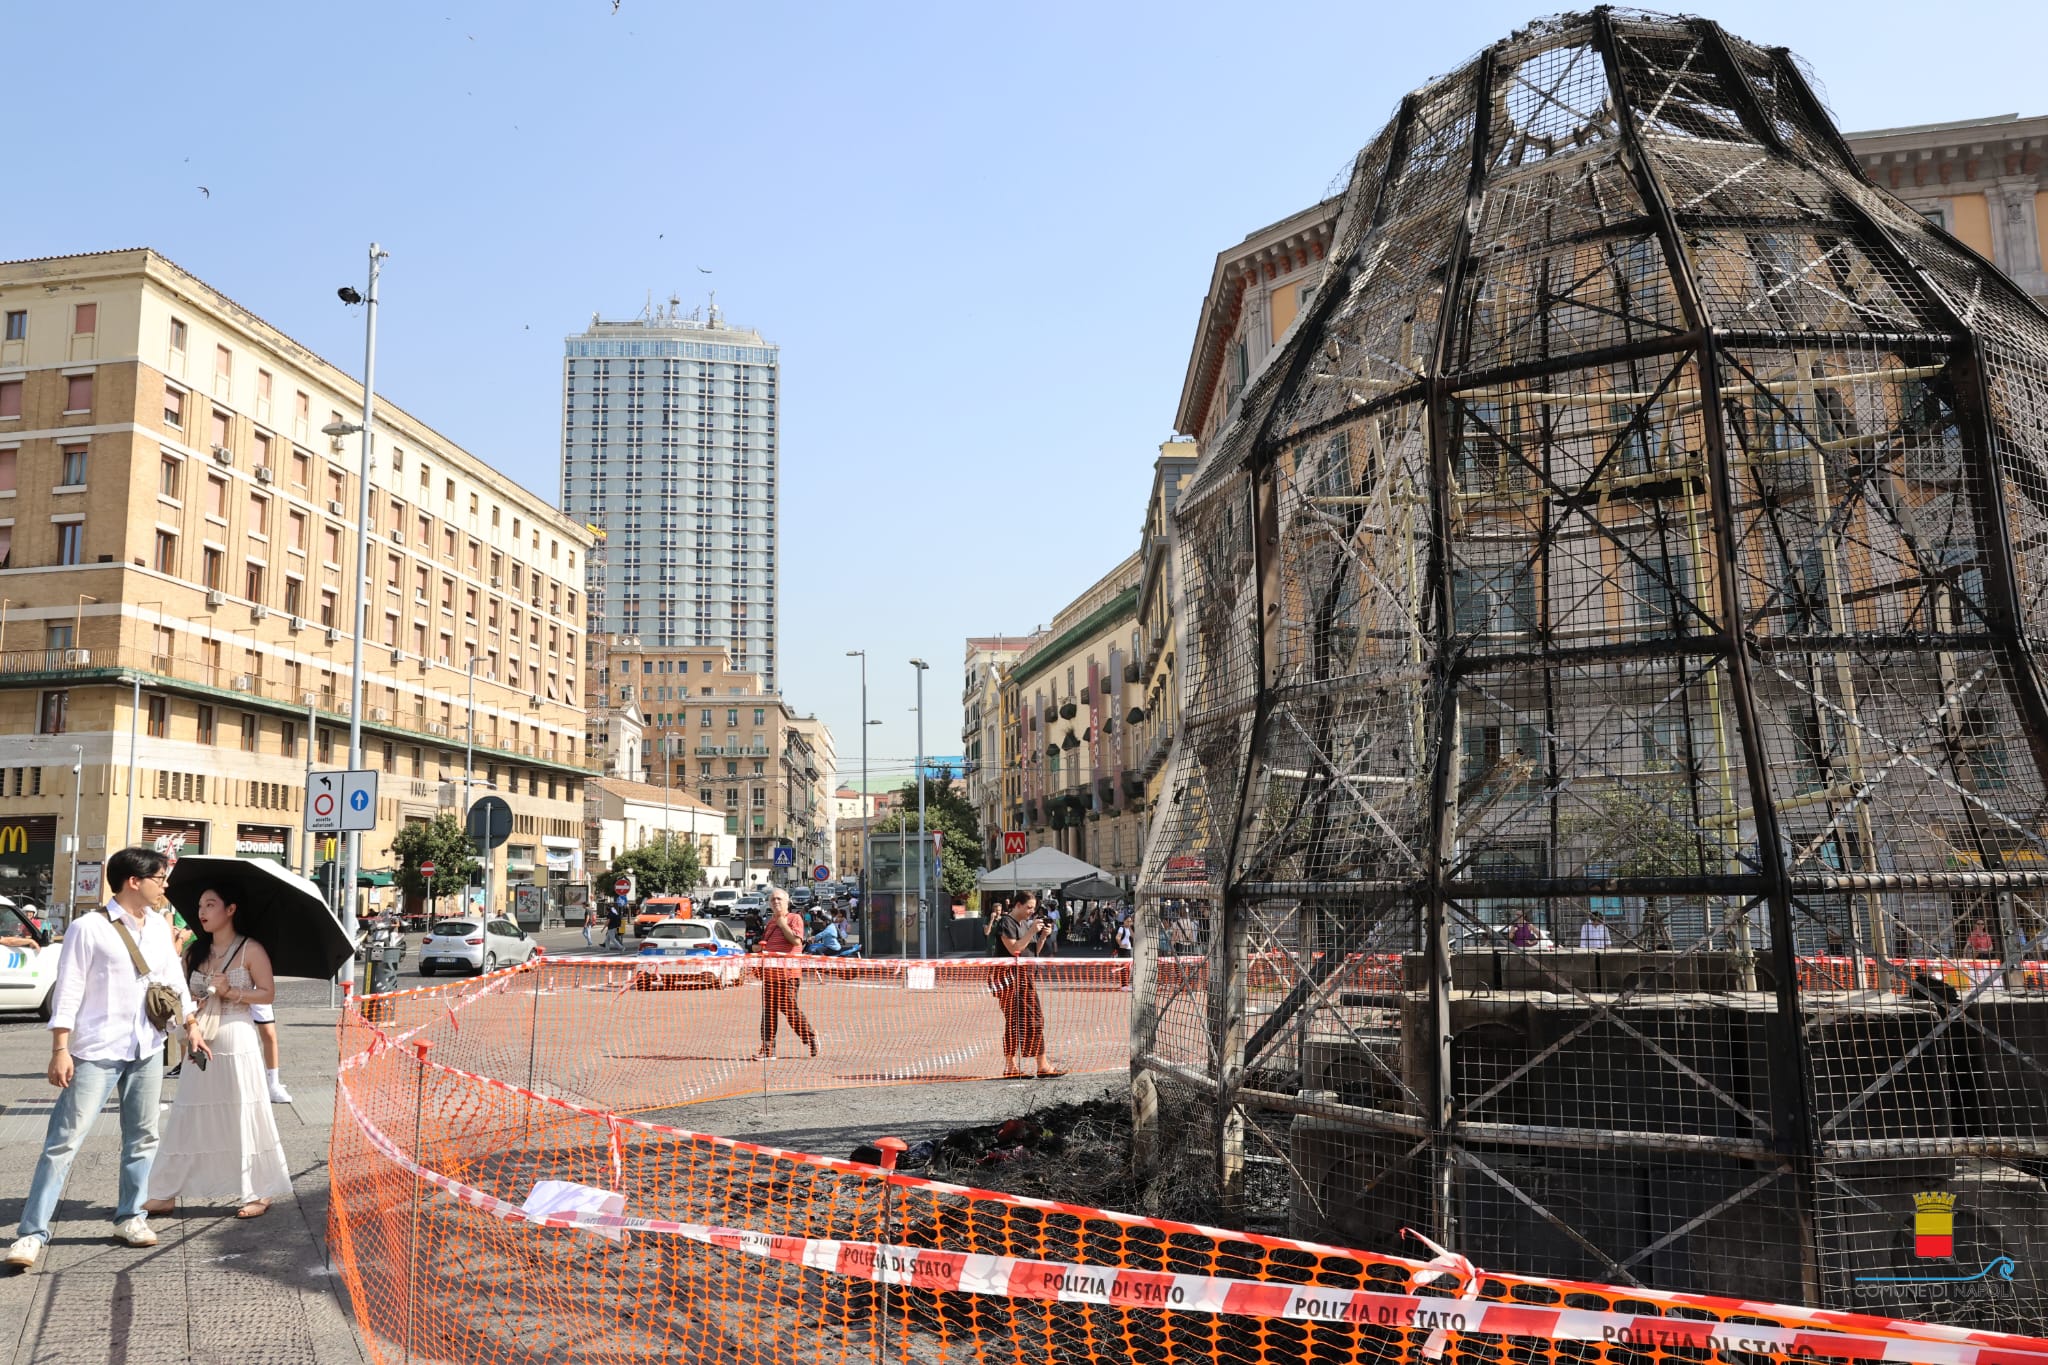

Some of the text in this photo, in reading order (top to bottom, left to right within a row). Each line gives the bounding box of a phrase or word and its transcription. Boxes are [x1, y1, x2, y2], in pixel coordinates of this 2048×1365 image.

[1007, 837, 1023, 849] M
[844, 1247, 951, 1278] POLIZIA DI STATO
[1044, 1272, 1184, 1304] POLIZIA DI STATO
[1295, 1298, 1466, 1331] POLIZIA DI STATO
